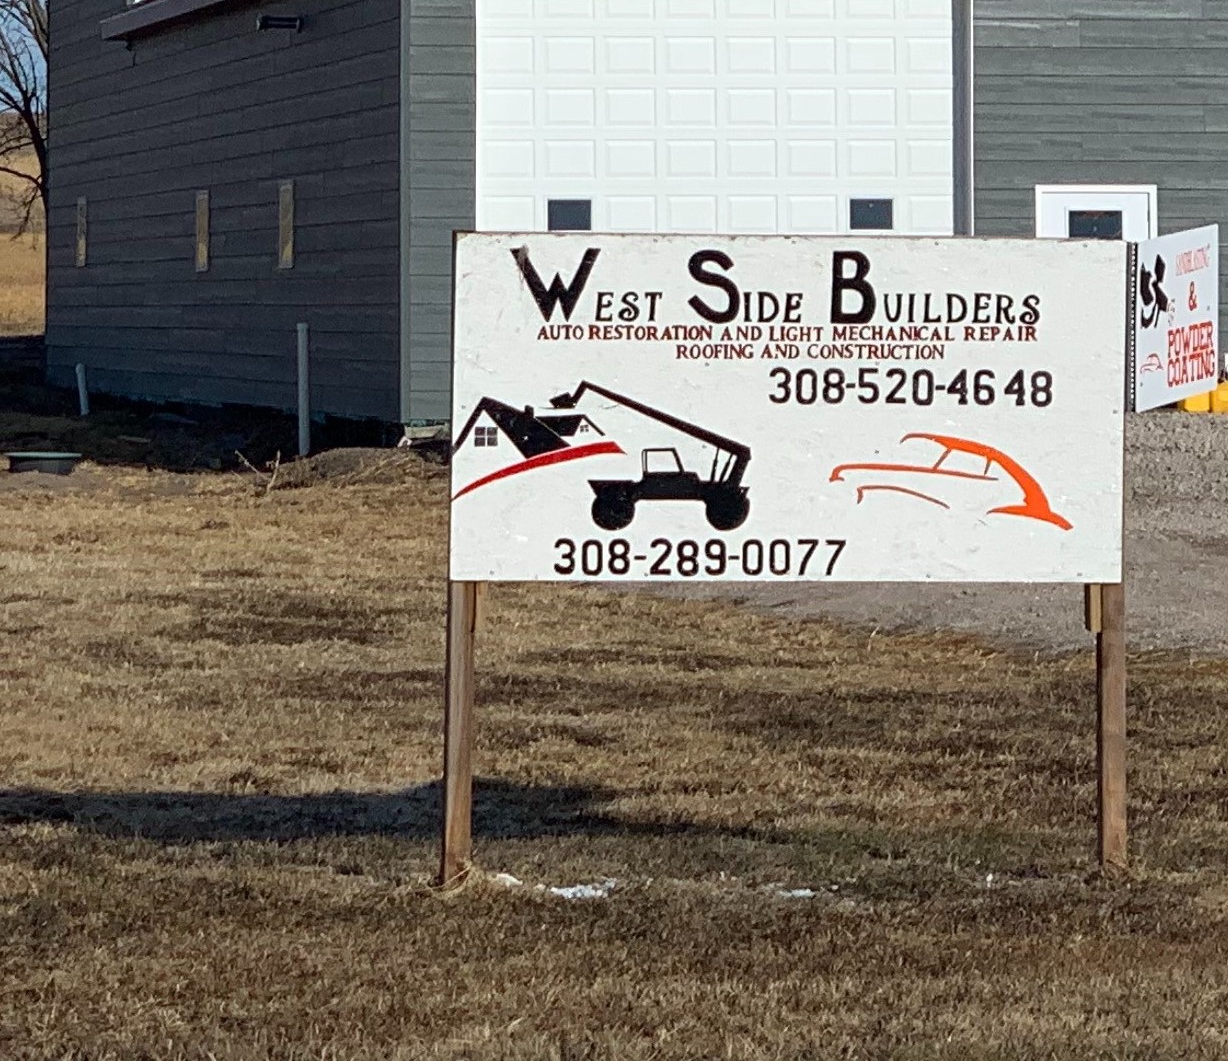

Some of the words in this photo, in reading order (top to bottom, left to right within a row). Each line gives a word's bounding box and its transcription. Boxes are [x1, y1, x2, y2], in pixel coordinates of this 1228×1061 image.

[510, 247, 663, 323] WEST
[688, 249, 804, 324] SIDE
[830, 250, 1041, 325] BUILDERS
[537, 324, 584, 340] AUTO
[588, 324, 713, 341] RESTORATION
[720, 325, 763, 341] AND
[769, 325, 824, 342] LIGHT
[832, 325, 955, 342] MECHANICAL
[963, 325, 1039, 342] REPAIR
[676, 343, 754, 360] ROOFING
[760, 343, 800, 360] AND
[807, 343, 945, 360] CONSTRUCTION
[1167, 320, 1214, 358] POWDER
[768, 366, 1053, 407] 308-520-4648
[1167, 349, 1216, 388] COATING
[553, 537, 847, 576] 308-289-0077
